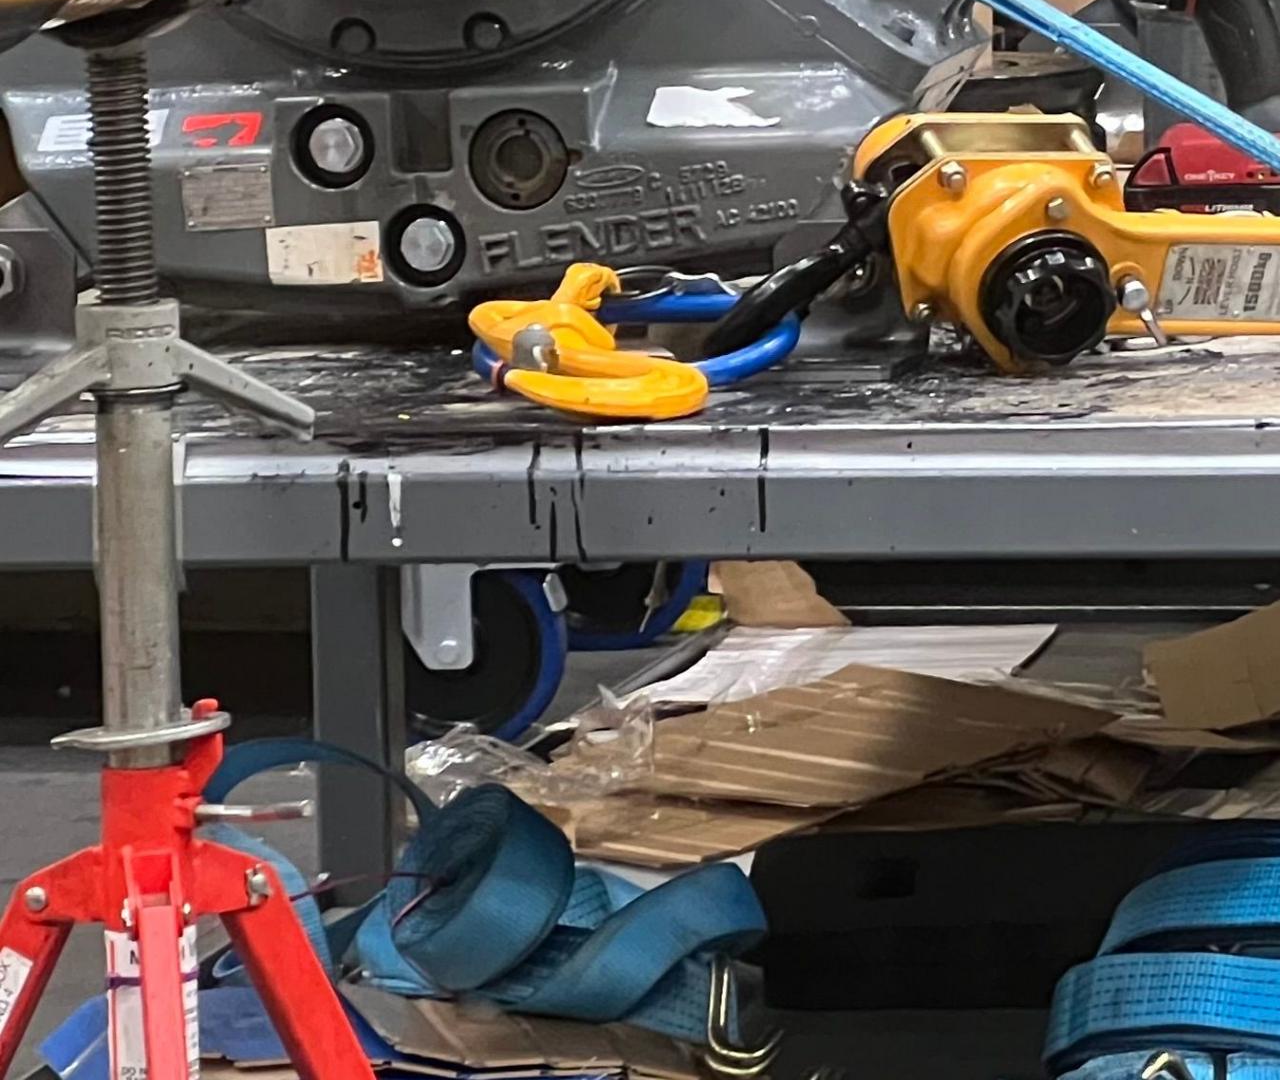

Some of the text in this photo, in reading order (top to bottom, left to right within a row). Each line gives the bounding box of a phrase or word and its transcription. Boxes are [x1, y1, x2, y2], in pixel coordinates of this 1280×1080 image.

[477, 203, 709, 275] FLENDER
[1217, 278, 1234, 316] LEVER
[1243, 252, 1273, 312] 1500kg
